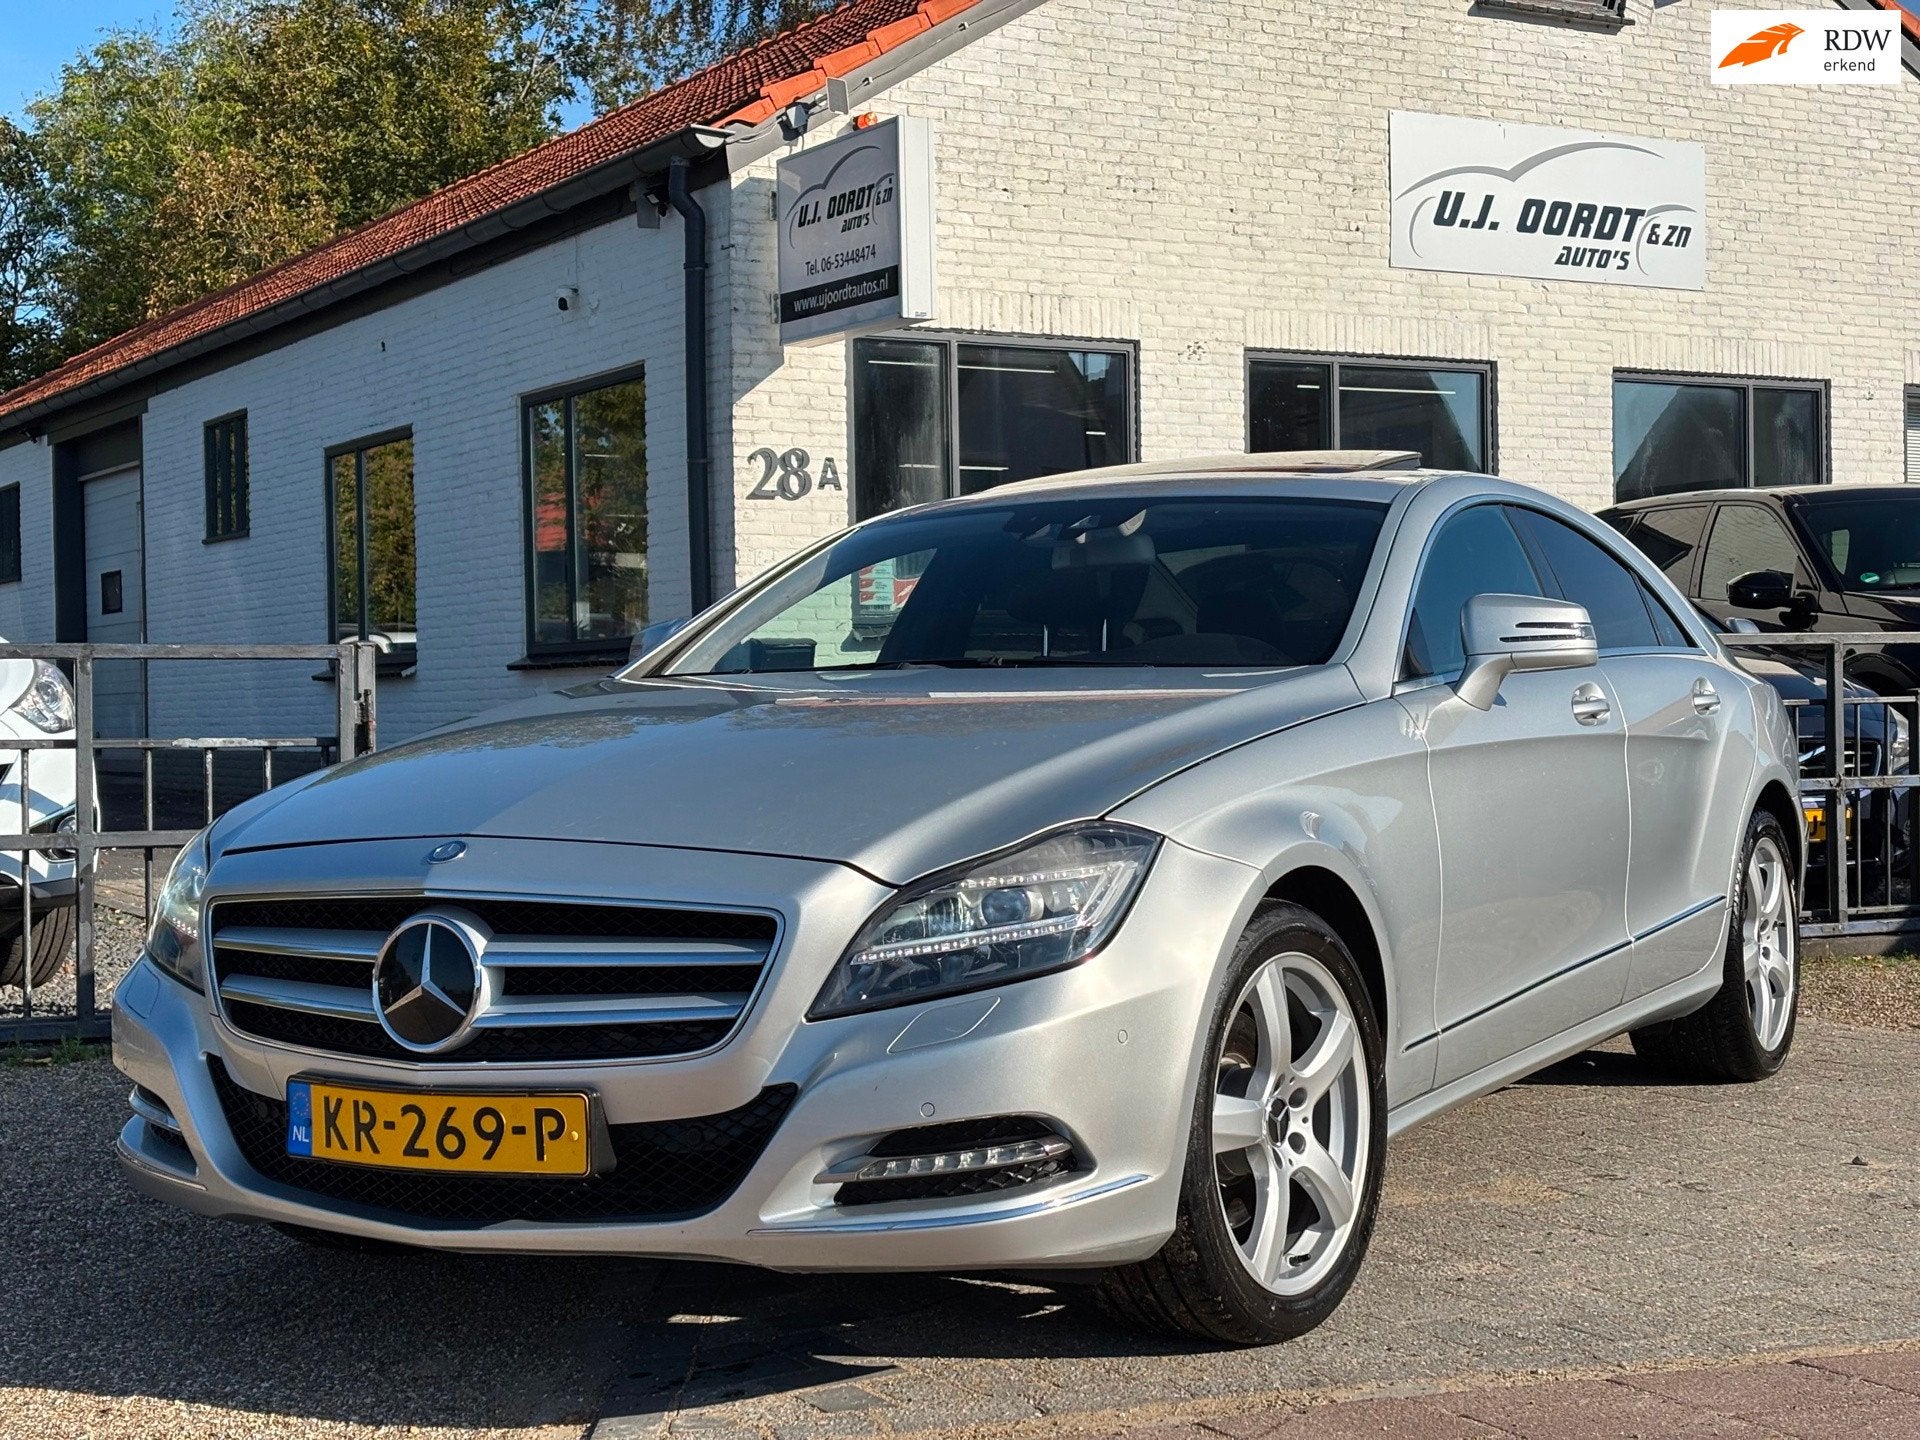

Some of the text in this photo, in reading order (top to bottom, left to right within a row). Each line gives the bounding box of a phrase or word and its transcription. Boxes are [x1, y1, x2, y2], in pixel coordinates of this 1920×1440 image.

[798, 201, 821, 228] U.J.
[826, 183, 875, 220] OORDT
[1433, 190, 1500, 231] U.J.
[1516, 198, 1647, 243] OORDT
[805, 244, 877, 277] Tel. 06-53448474
[793, 273, 888, 312] www.ujoordtautos.nl
[745, 447, 842, 501] 28 A
[292, 1124, 309, 1143] NL
[323, 1095, 567, 1162] KR-269-P
